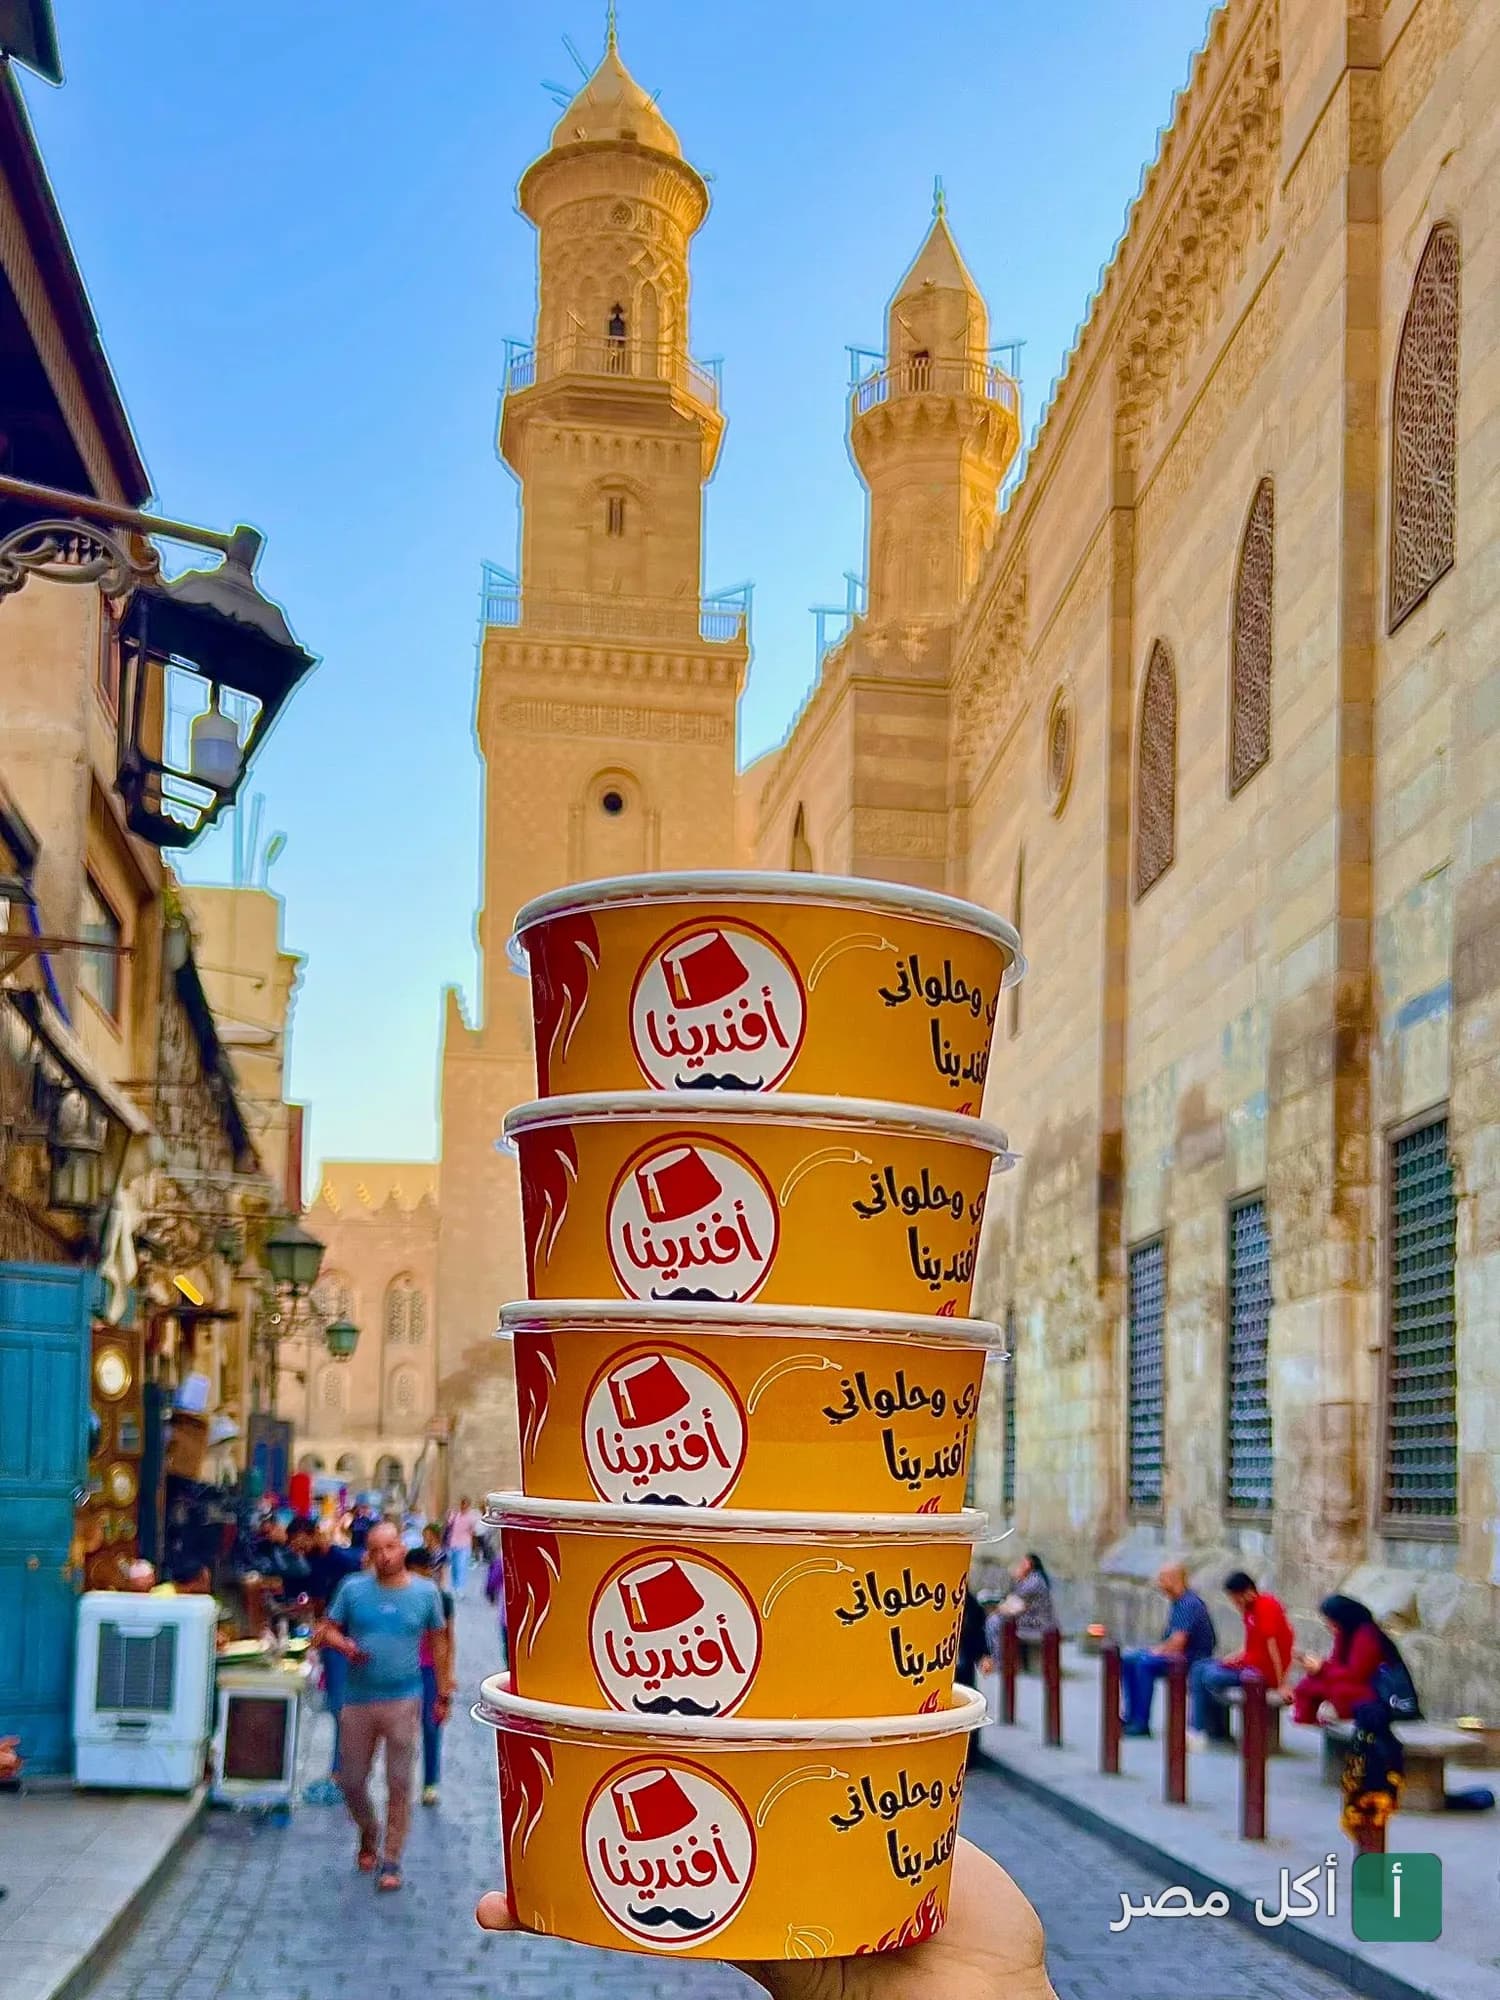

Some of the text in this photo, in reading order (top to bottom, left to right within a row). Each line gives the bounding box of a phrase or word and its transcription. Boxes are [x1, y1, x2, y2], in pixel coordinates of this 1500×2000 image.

[878, 954, 981, 1017] وحلواني
[645, 984, 791, 1068] أفندينا
[852, 1165, 964, 1220] وحلواني
[622, 1200, 763, 1281] أفندينا
[908, 1226, 981, 1291] فندينا
[822, 1370, 946, 1425] وحلواني
[596, 1408, 731, 1486] أفندينا
[881, 1423, 969, 1491] أفندينا
[834, 1567, 946, 1626] وحلواني
[605, 1614, 746, 1691] أفندينا
[829, 1769, 943, 1832] وحلواني
[598, 1824, 740, 1900] أفندينا
